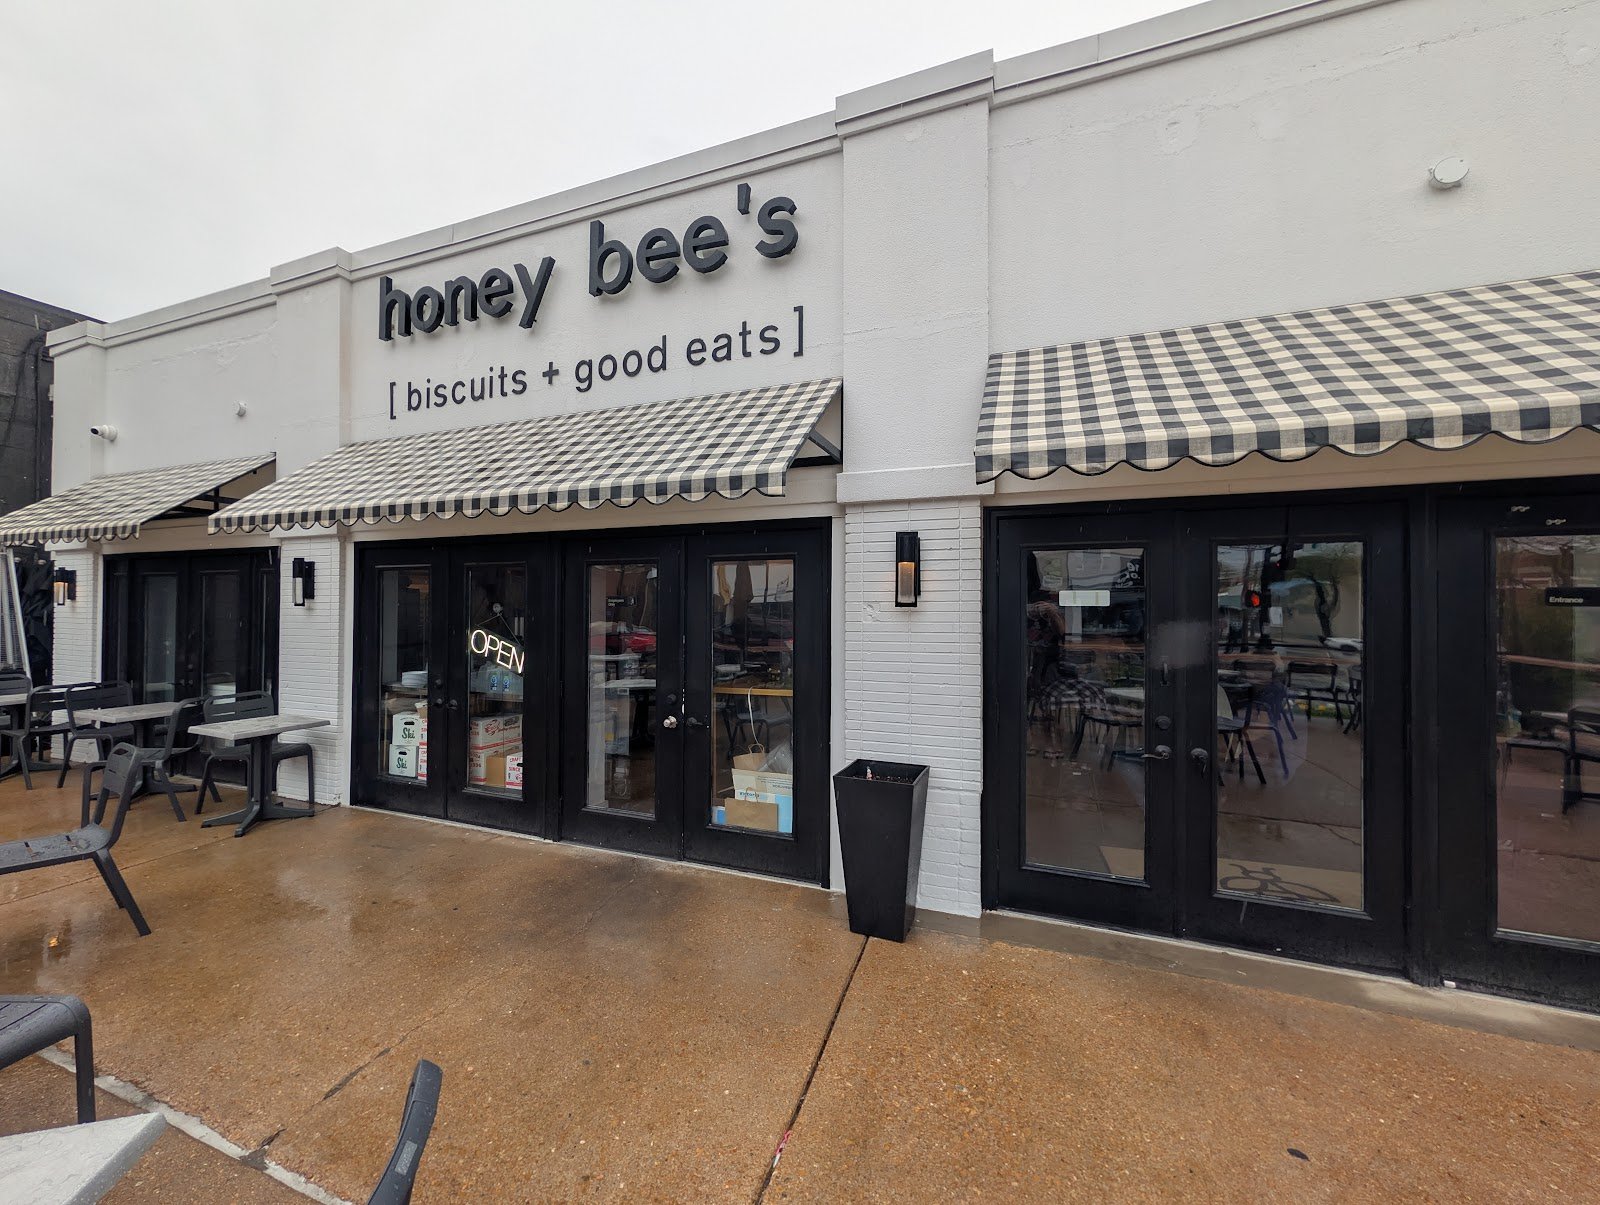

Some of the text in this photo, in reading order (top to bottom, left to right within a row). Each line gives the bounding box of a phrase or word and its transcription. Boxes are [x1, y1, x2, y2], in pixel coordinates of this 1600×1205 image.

[379, 182, 798, 342] honey bee's
[407, 366, 528, 412] biscuits
[542, 361, 560, 385] +
[575, 335, 667, 393] good
[686, 320, 781, 366] eats
[1549, 596, 1584, 604] Entrance
[471, 629, 525, 674] OPEN
[401, 727, 416, 740] Ski
[396, 757, 408, 769] Ski
